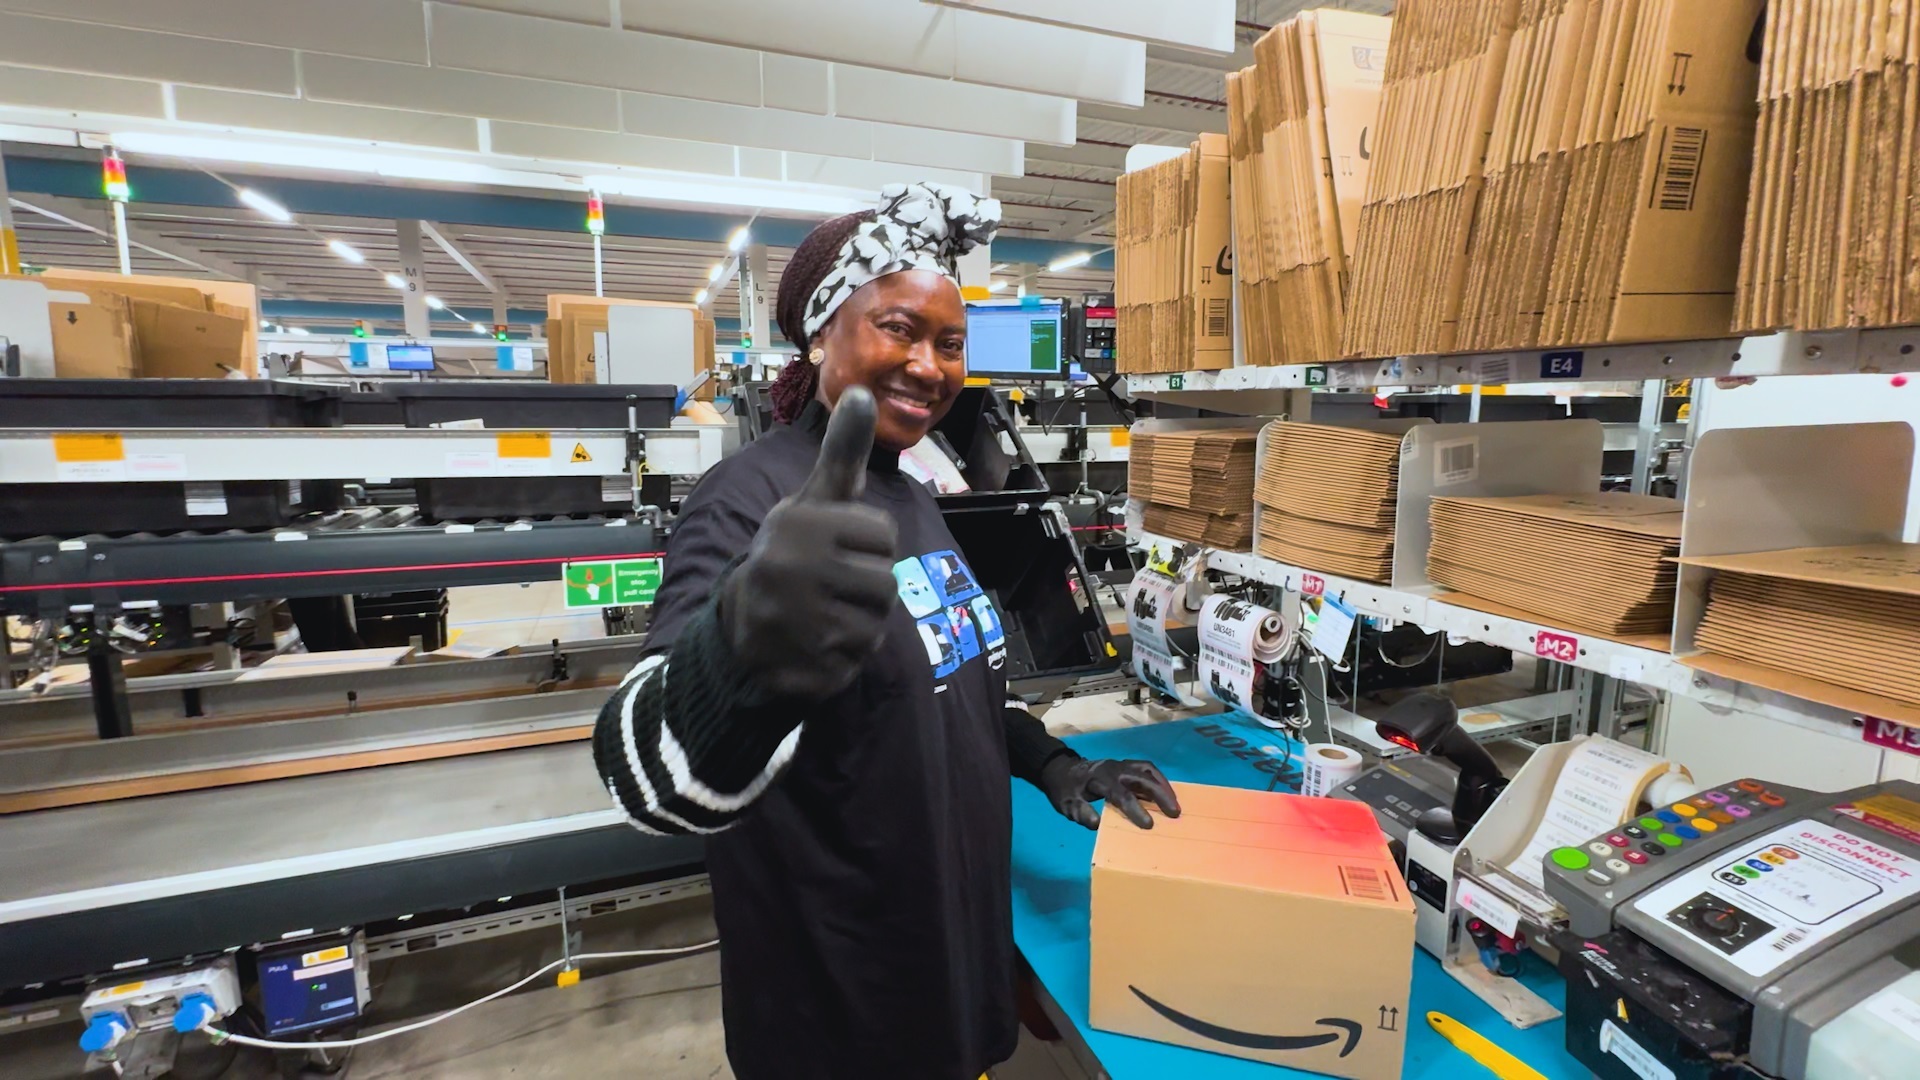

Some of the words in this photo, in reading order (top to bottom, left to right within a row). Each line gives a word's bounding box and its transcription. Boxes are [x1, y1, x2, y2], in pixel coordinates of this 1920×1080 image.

[405, 267, 417, 277] M
[408, 282, 416, 292] 9
[755, 282, 764, 291] L
[757, 295, 764, 304] 9
[1550, 357, 1574, 374] E4
[1171, 377, 1181, 388] E1
[1213, 622, 1236, 638] UN3481
[1542, 638, 1574, 658] M2
[1833, 833, 1860, 845] DO
[1862, 845, 1905, 862] NOT
[1799, 832, 1912, 878] DISCONNECT
